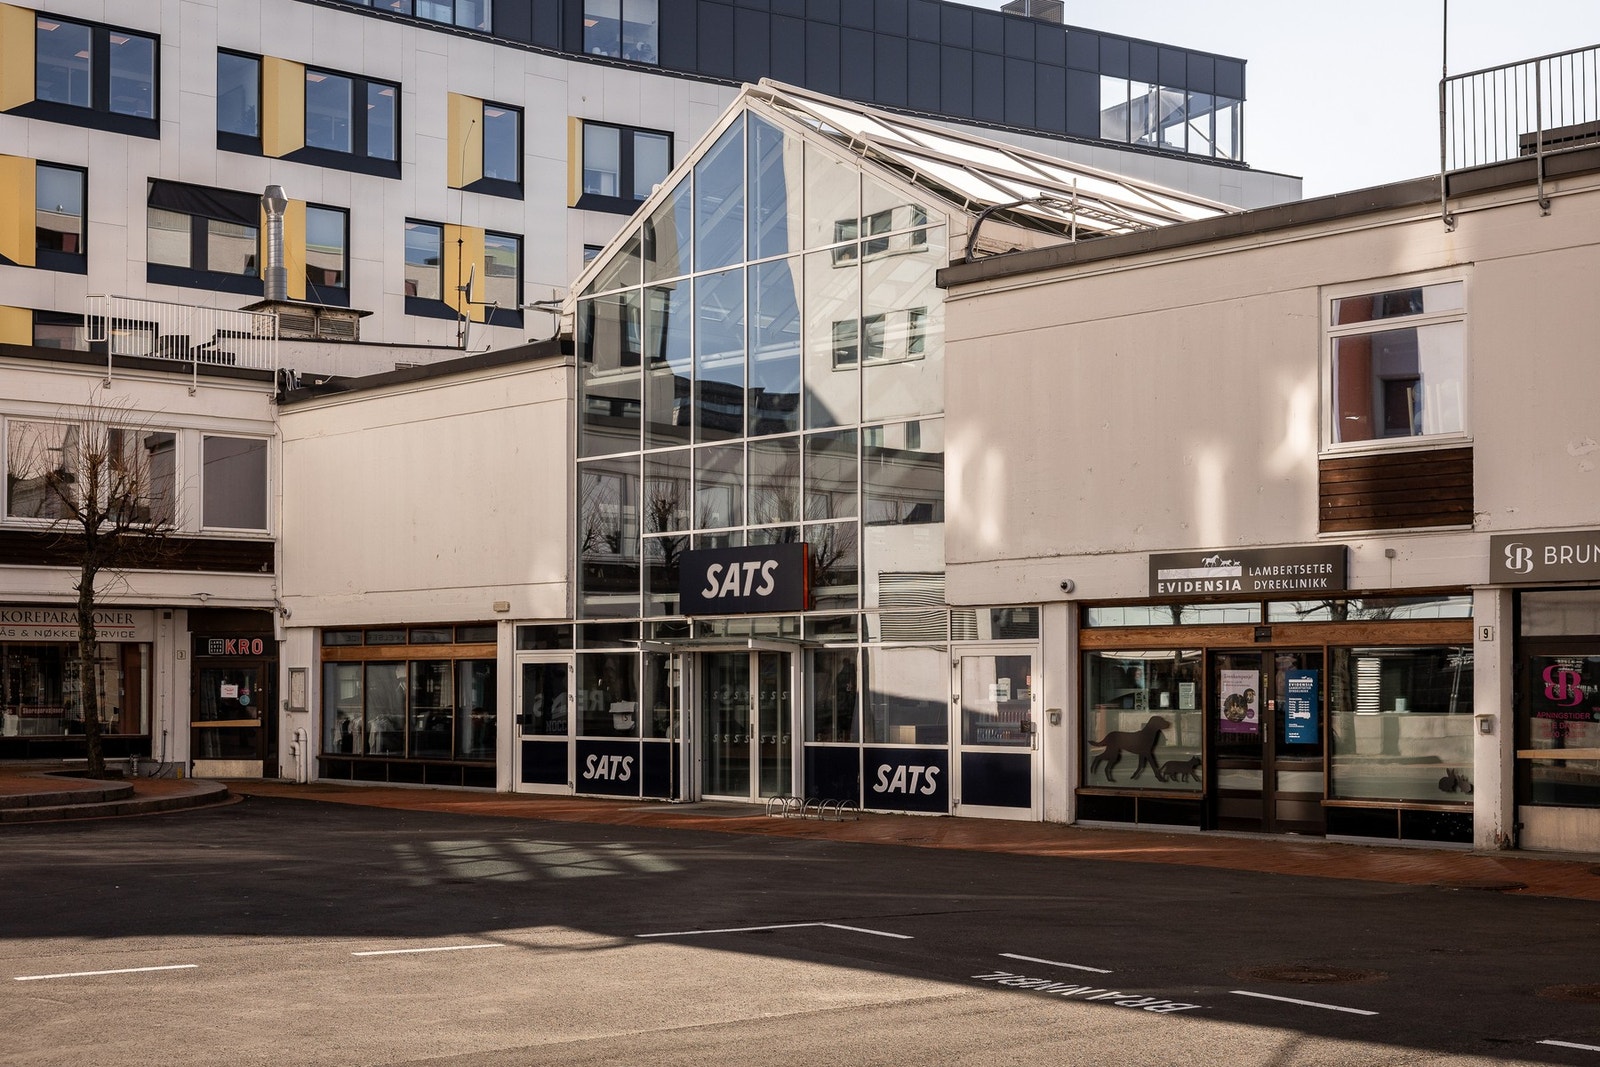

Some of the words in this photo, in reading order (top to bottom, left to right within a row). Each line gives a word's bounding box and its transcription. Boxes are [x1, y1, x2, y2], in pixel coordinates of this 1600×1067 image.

[1249, 563, 1333, 576] LAMBERTSETER
[701, 559, 779, 600] SATS
[1157, 579, 1242, 593] EVIDENSIA
[1254, 577, 1328, 590] DYREKLINIKK
[1, 610, 135, 624] KOREPARAONER
[21, 629, 30, 637] &
[1483, 628, 1489, 639] 9
[225, 638, 264, 655] KRO
[582, 753, 634, 782] SATS
[872, 763, 941, 795] SATS
[970, 970, 1203, 1014] BRANNBIL
